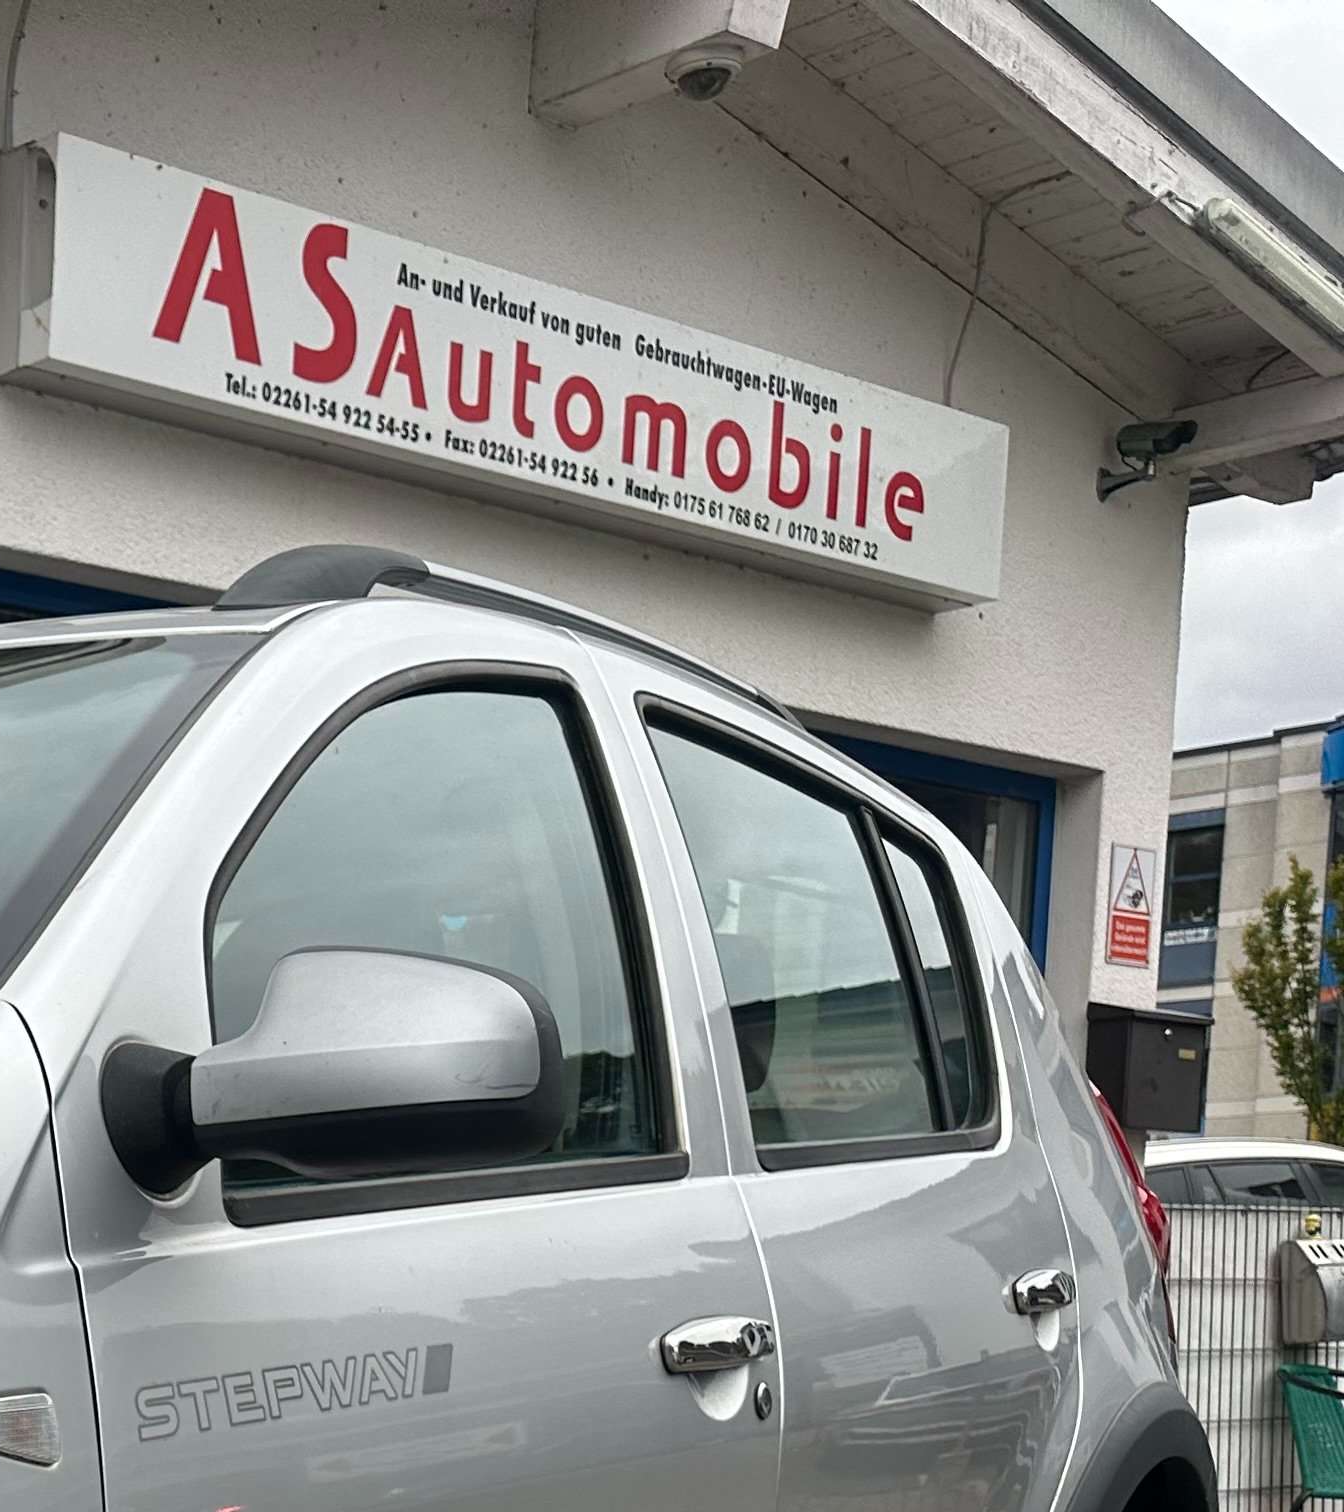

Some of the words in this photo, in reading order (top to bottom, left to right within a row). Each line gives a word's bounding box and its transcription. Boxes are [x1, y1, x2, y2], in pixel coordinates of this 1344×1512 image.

[397, 262, 426, 291] An-
[432, 280, 463, 304] und
[470, 284, 536, 325] Verkauf
[541, 311, 570, 335] von
[575, 322, 622, 351] guten
[225, 373, 257, 400] Tel.:
[262, 382, 337, 421] 02261-54
[342, 405, 372, 430] 922
[377, 414, 419, 442] 54-55
[444, 430, 475, 454] Fax:
[479, 438, 547, 474] 02261-54
[552, 458, 578, 482] 922
[582, 466, 599, 487] 56
[624, 478, 670, 510] Handy:
[673, 491, 705, 515] 0175
[708, 500, 723, 520] 61
[728, 504, 750, 527] 768
[754, 512, 769, 532] 62
[788, 523, 817, 545] 0170
[821, 530, 835, 549] 30
[839, 534, 860, 555] 687
[863, 541, 878, 560] 32
[366, 304, 925, 542] Automobile
[136, 1348, 418, 1442] STEPWAY
